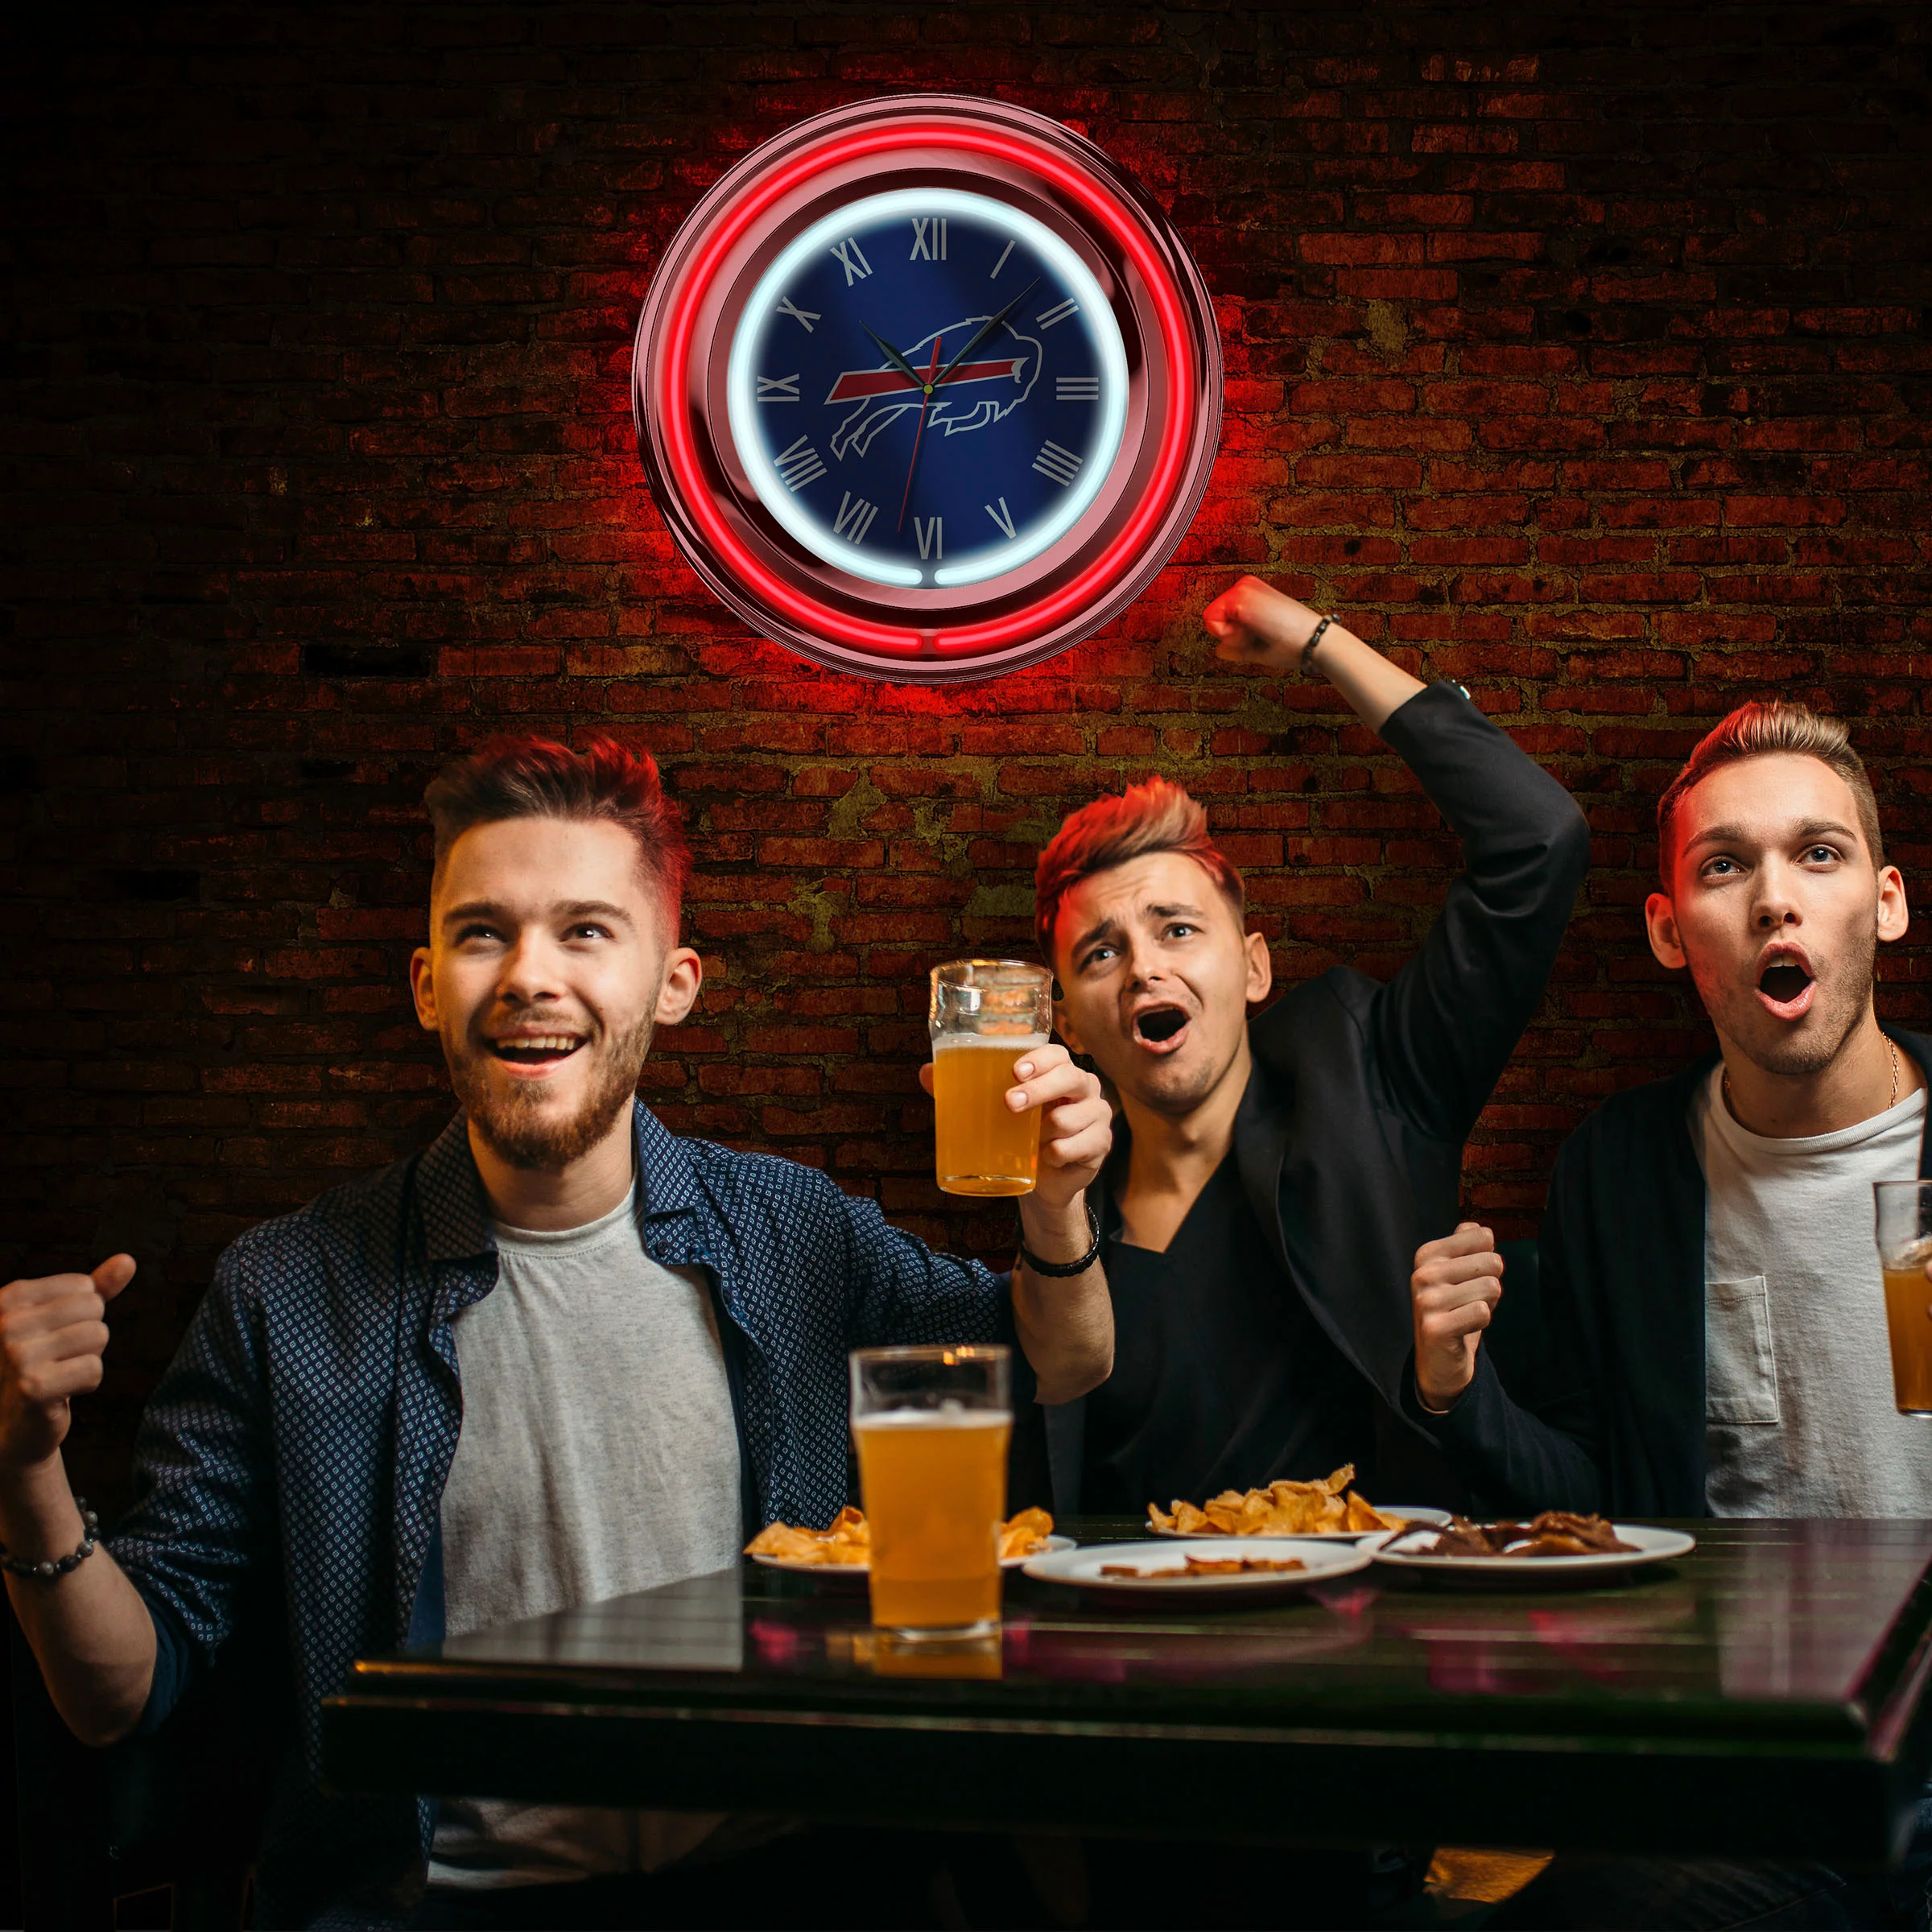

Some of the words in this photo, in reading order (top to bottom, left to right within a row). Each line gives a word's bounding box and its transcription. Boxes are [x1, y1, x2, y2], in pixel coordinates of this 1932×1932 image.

[910, 217, 947, 261] XII
[990, 239, 1015, 279] I
[829, 237, 873, 287] XI
[776, 296, 822, 332] X
[1036, 298, 1080, 330] II
[757, 374, 800, 402] IX
[1056, 377, 1099, 400] III
[774, 434, 828, 492] VIII
[1031, 440, 1084, 486] IIII
[833, 490, 878, 545] VII
[914, 517, 943, 560] VI
[985, 497, 1017, 540] V
